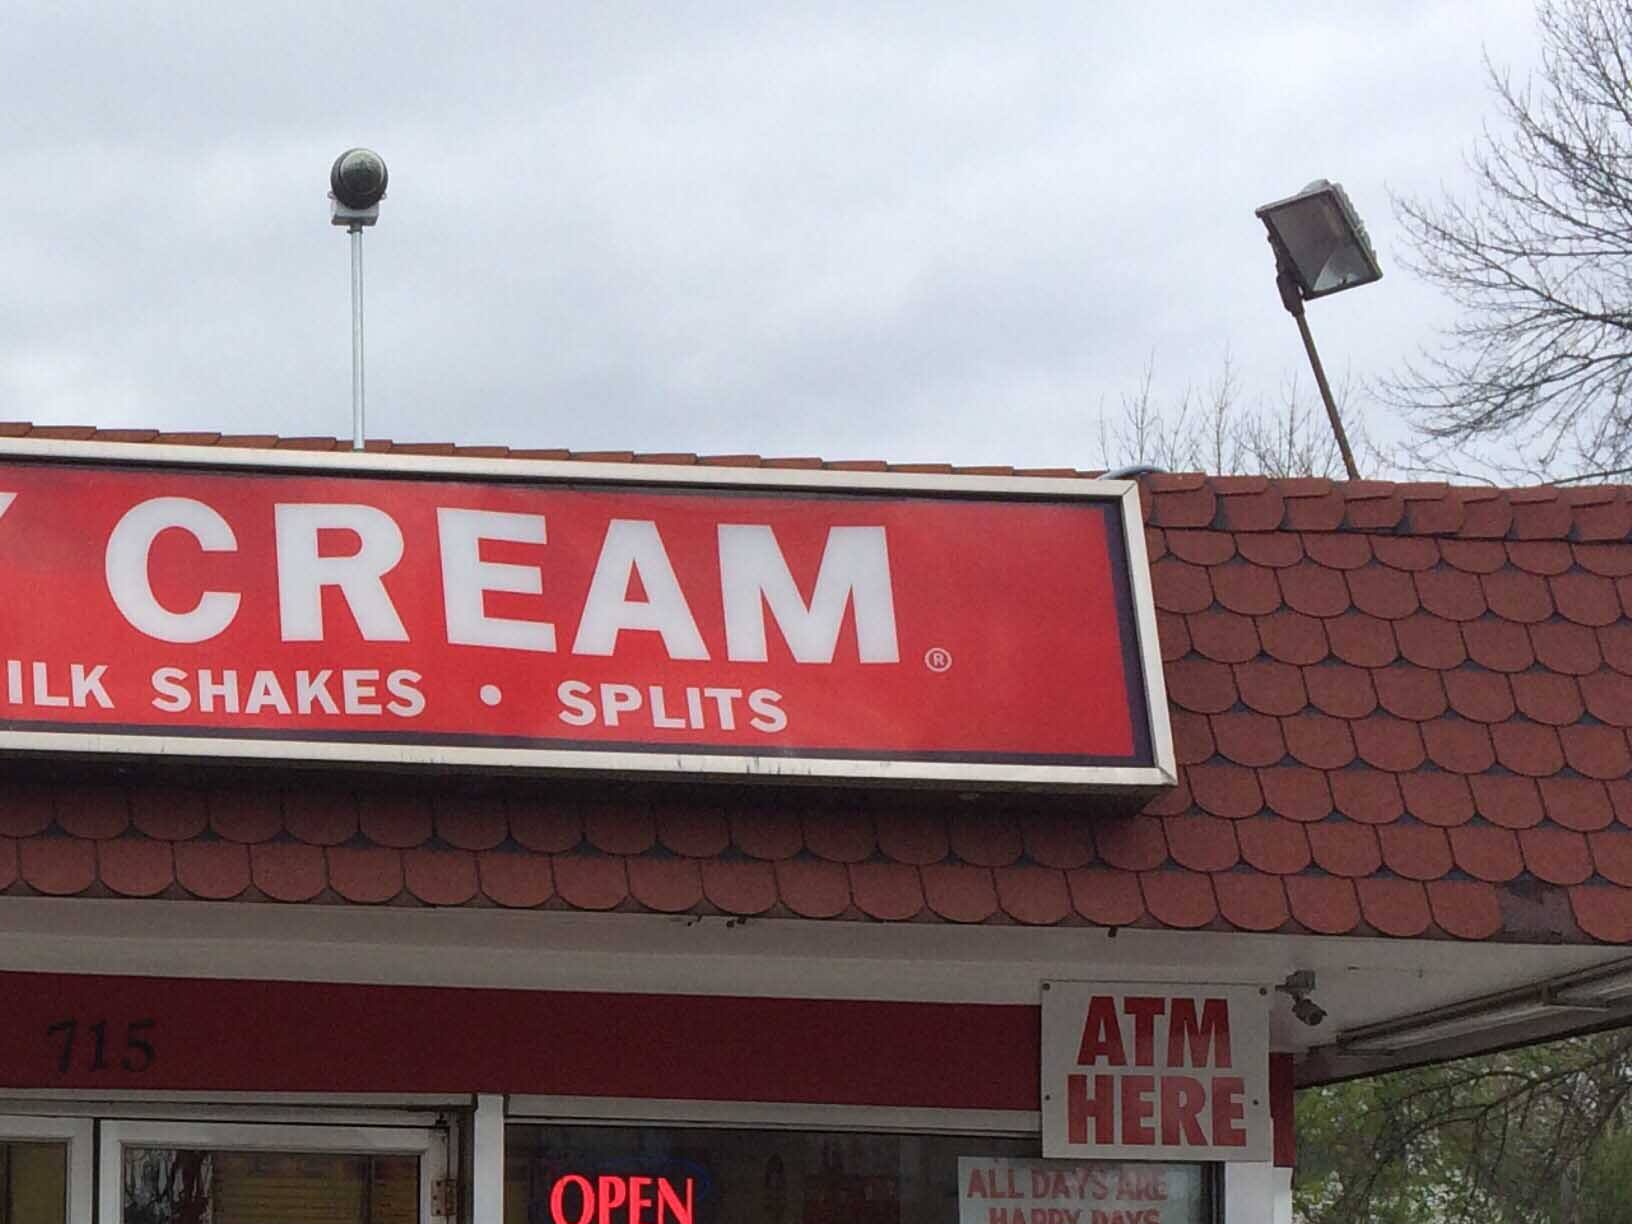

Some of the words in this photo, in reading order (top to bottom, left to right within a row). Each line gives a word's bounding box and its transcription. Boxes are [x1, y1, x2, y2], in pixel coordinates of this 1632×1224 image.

[104, 495, 901, 665] CREAM
[150, 666, 427, 718] SHAKES
[556, 679, 789, 734] SPLITS
[47, 1016, 156, 1073] 715
[1076, 996, 1233, 1069] ATM
[1067, 1074, 1248, 1148] HERE
[967, 1167, 1025, 1199] ALL
[1031, 1166, 1109, 1201] DAYS
[1117, 1166, 1168, 1201] ARE
